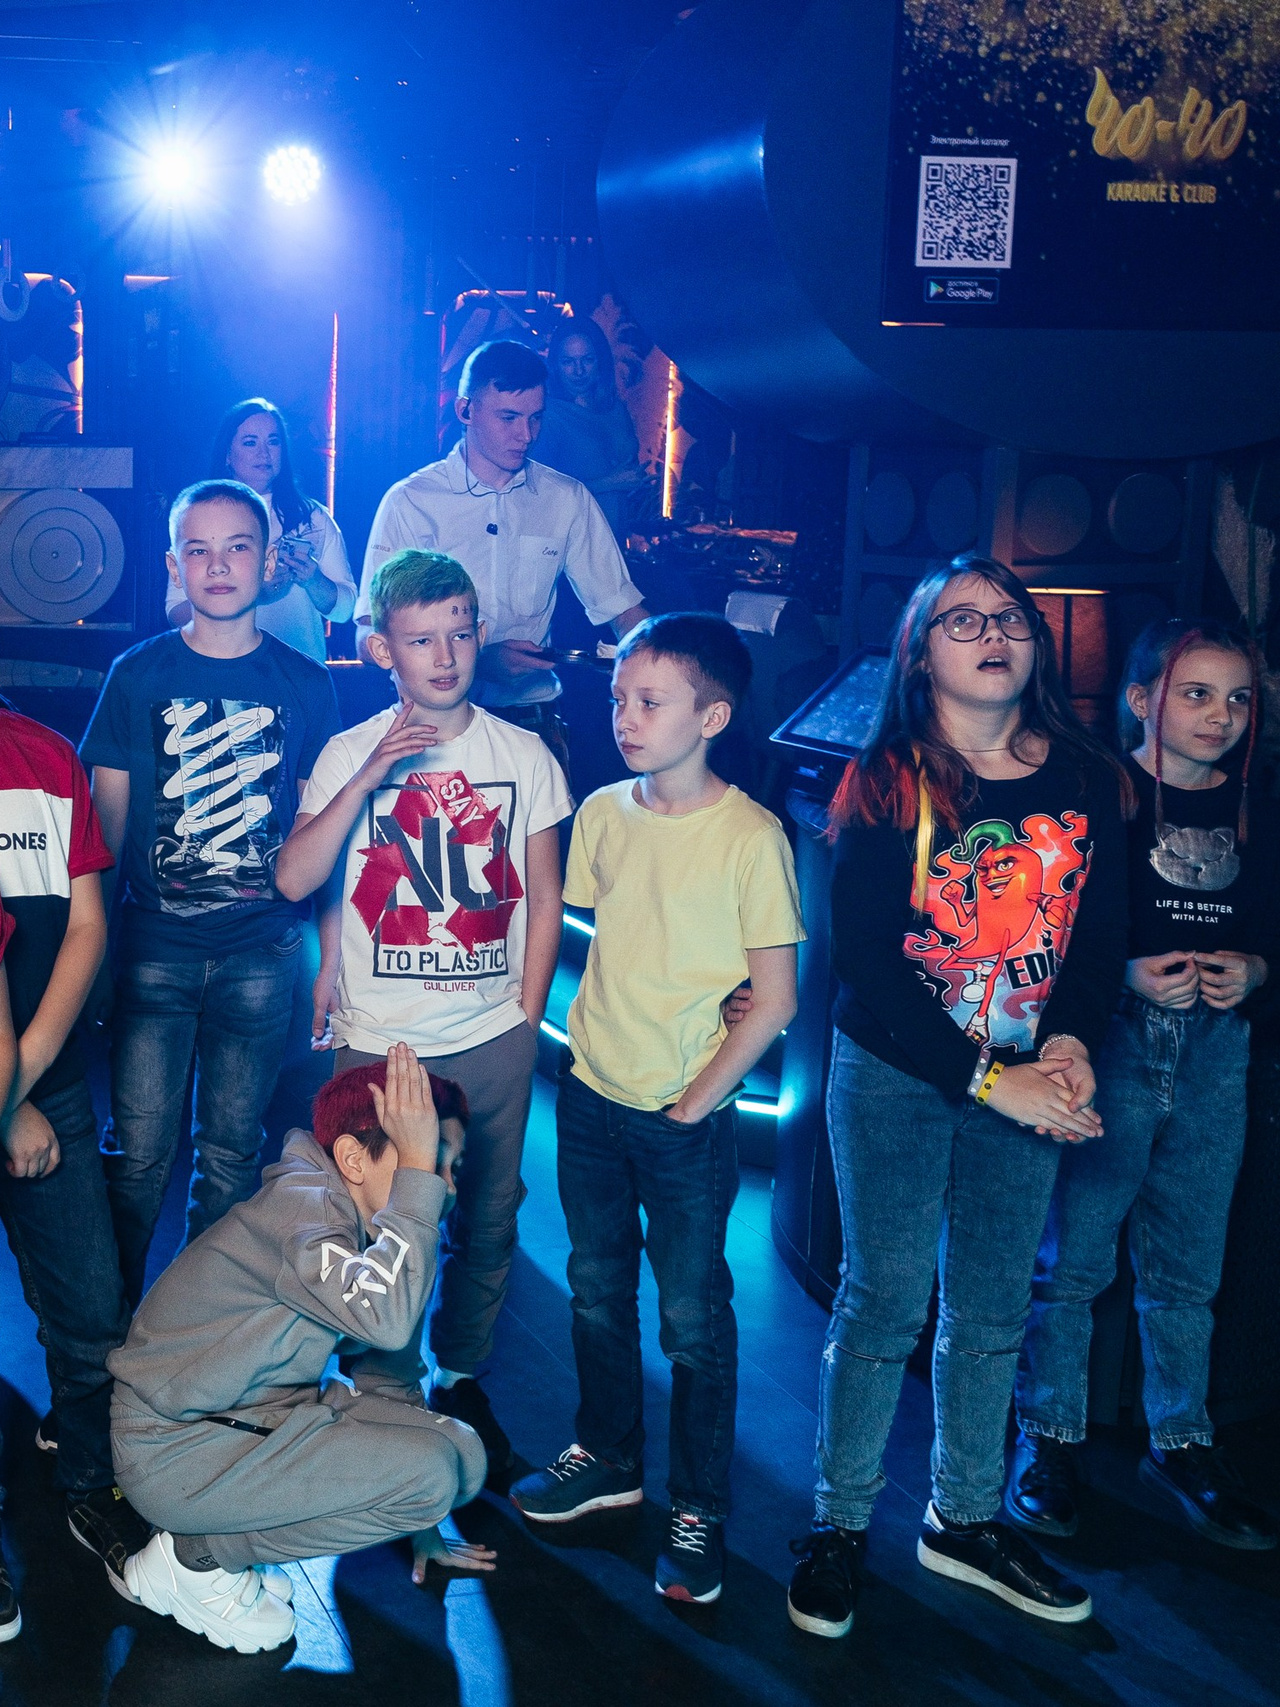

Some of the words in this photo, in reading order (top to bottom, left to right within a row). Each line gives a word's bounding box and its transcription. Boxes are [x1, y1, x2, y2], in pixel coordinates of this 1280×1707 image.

[1086, 66, 1247, 160] 40-40
[1107, 182, 1167, 203] KARAOKE
[1183, 184, 1217, 204] CLUB
[947, 288, 976, 299] Google
[440, 778, 485, 828] SAY
[374, 815, 508, 913] NO
[1156, 900, 1180, 909] LIFE
[1184, 901, 1194, 910] IS
[1197, 902, 1233, 914] BETTER
[1171, 913, 1195, 921] WITH
[383, 949, 412, 972] TO
[419, 948, 505, 973] PLASTIC
[423, 981, 476, 993] GULLIVER
